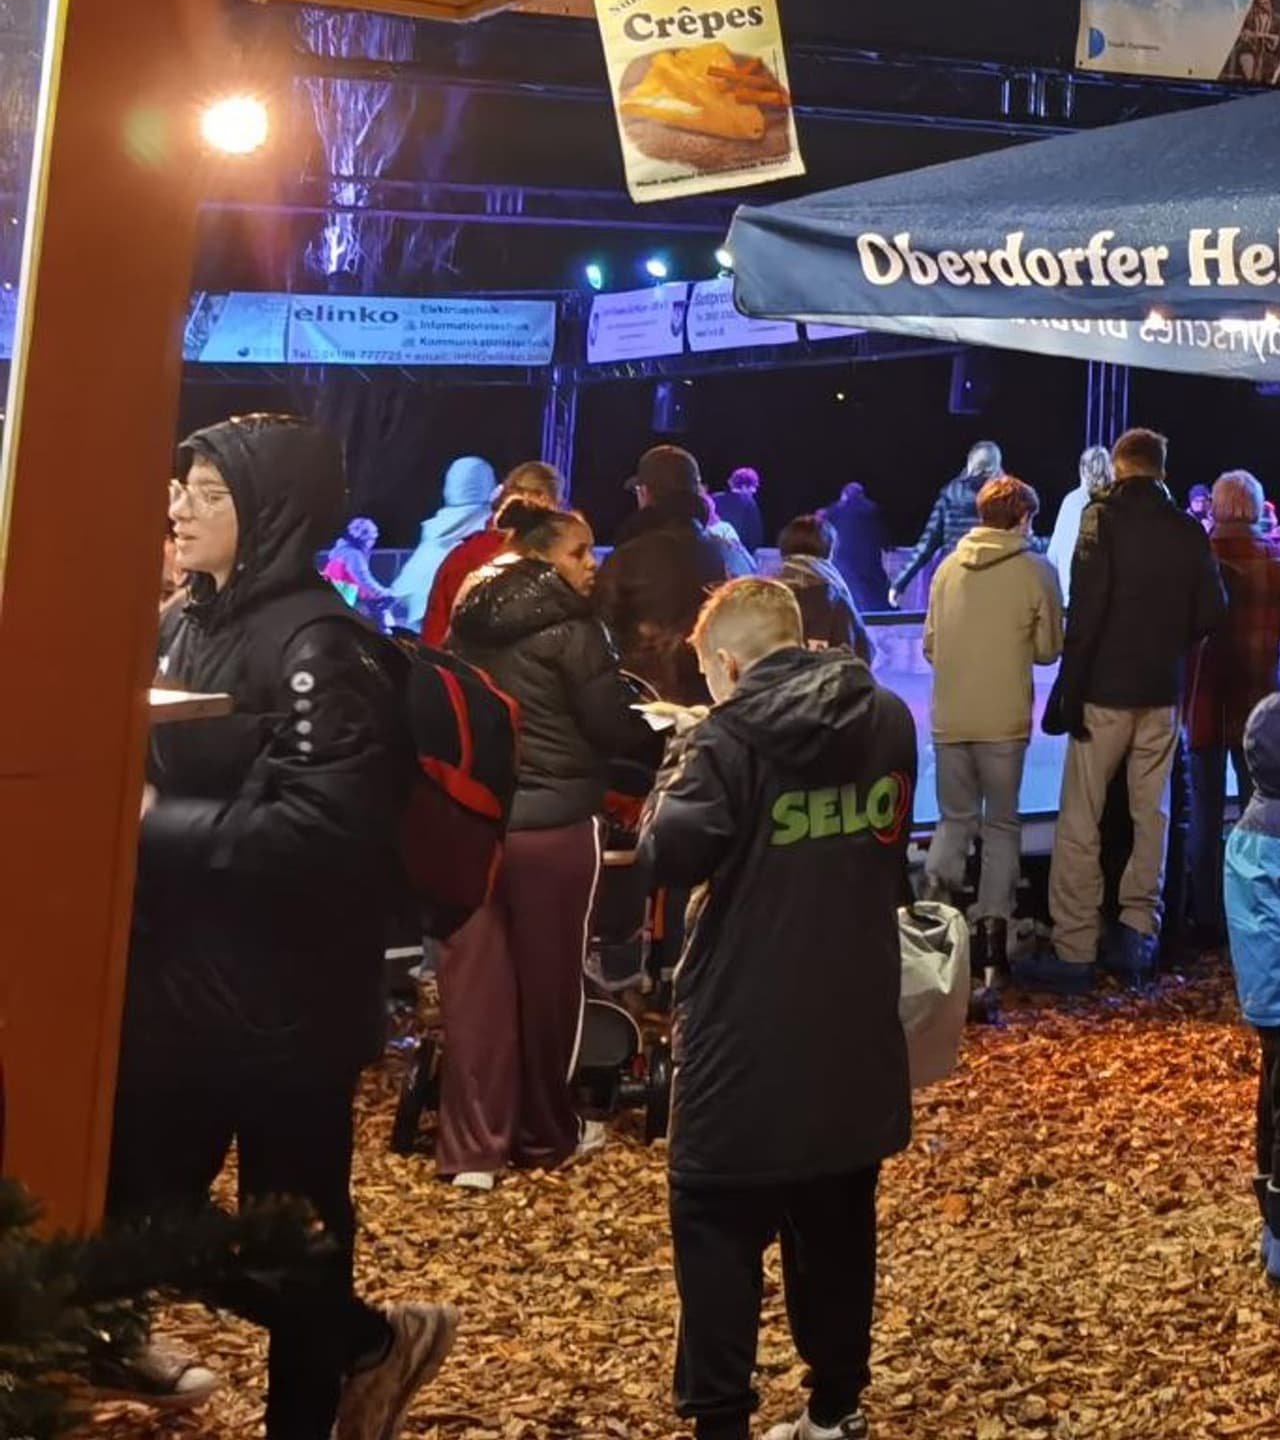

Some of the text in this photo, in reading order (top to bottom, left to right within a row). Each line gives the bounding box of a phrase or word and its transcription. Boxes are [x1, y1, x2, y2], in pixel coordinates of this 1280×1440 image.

[623, 5, 764, 42] Crêpes
[856, 230, 1169, 287] Oberdorfer
[294, 305, 400, 324] elinko
[770, 774, 900, 847] SELO
